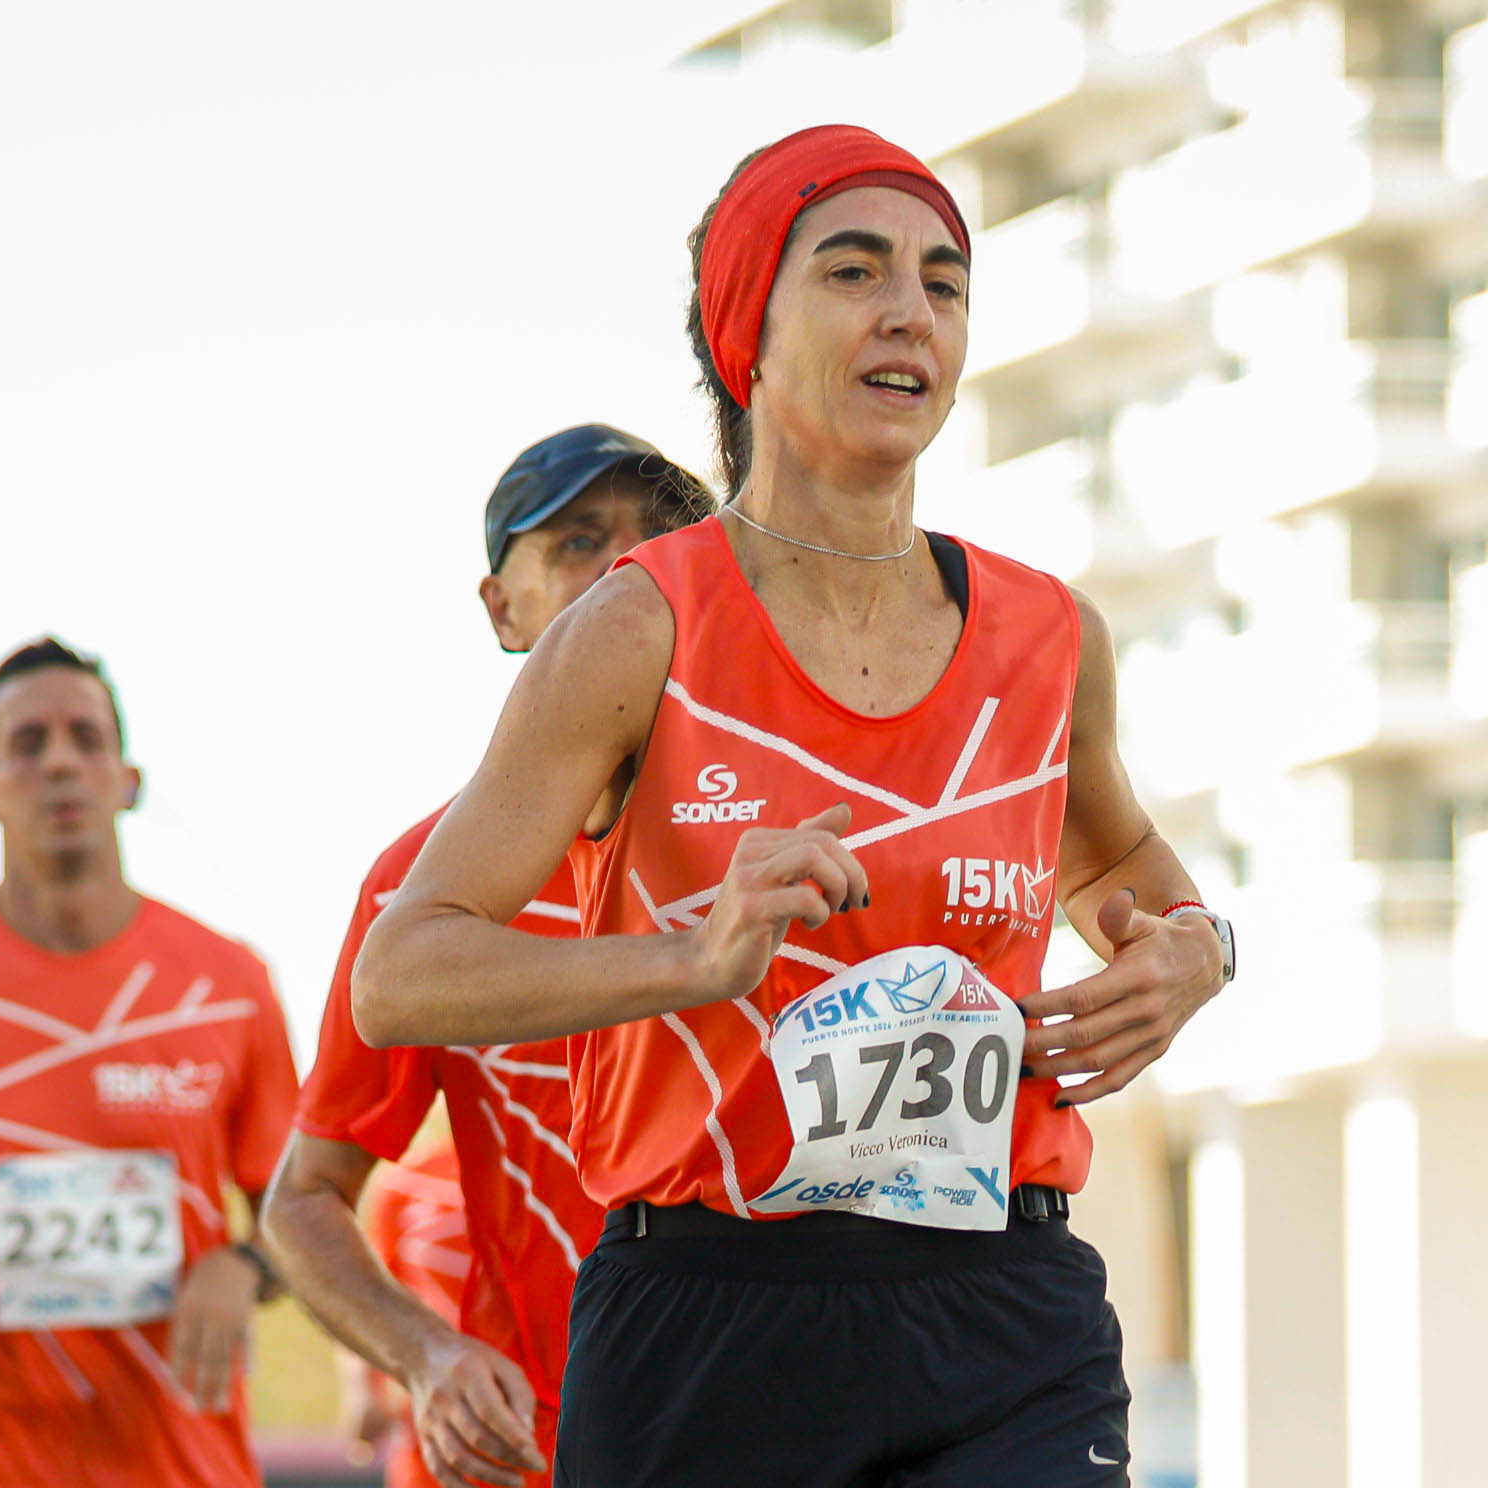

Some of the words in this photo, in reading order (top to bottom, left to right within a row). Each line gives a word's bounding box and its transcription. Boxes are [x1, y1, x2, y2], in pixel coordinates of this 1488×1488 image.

[942, 857, 1020, 911] 15K
[795, 981, 879, 1033] 15K
[960, 983, 989, 1005] 15K
[795, 1031, 1009, 1142] 1730
[849, 1144, 884, 1159] Vicco
[888, 1129, 948, 1152] Veronica
[795, 1175, 876, 1203] osde
[1, 1205, 167, 1265] 2242
